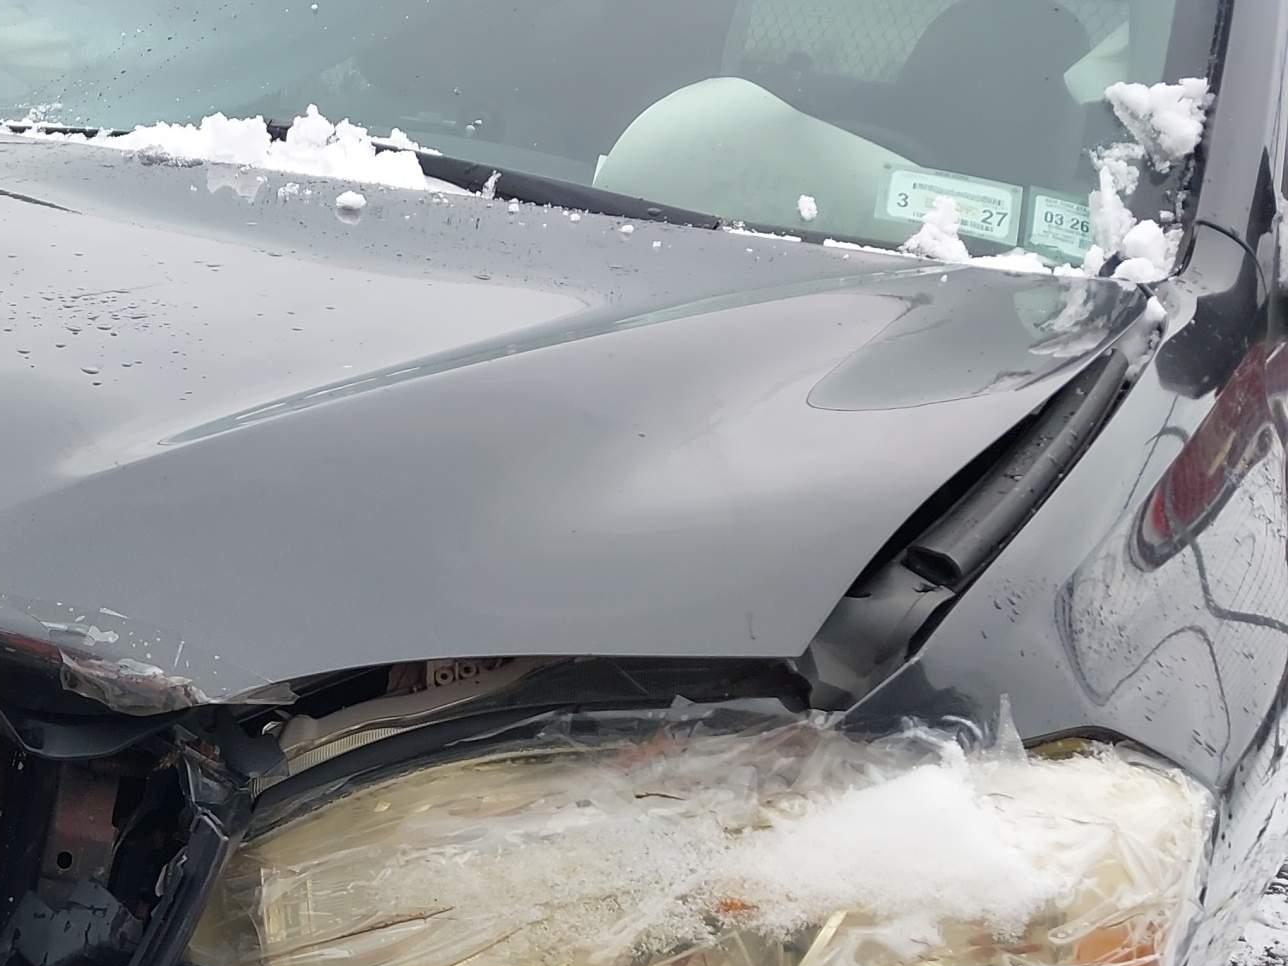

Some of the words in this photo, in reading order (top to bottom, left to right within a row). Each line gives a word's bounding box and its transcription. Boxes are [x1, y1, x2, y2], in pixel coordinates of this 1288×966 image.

[897, 192, 909, 208] 3
[981, 208, 1008, 227] 27
[1044, 211, 1064, 226] 03
[1070, 217, 1090, 233] 26
